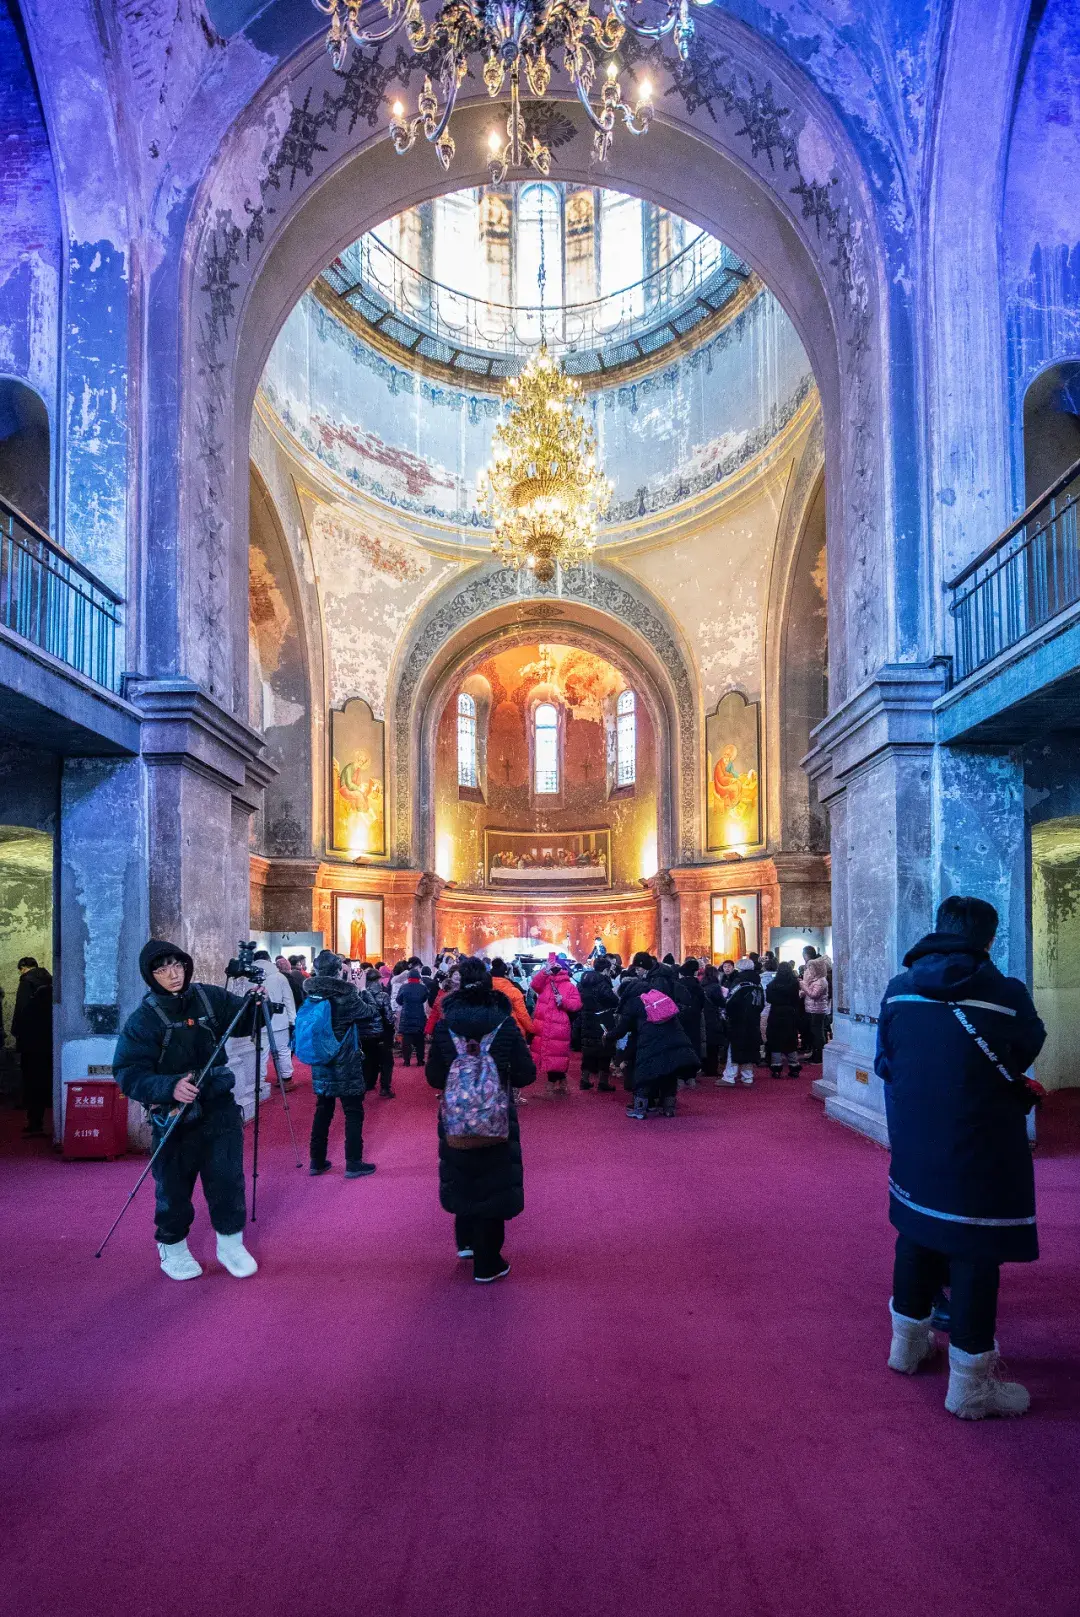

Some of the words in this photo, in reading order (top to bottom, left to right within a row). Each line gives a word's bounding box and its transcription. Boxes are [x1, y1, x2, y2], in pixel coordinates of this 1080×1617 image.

[953, 1008, 977, 1034] NikeAir
[974, 1036, 998, 1061] NikeAir
[75, 1096, 105, 1105] 灭火器箱
